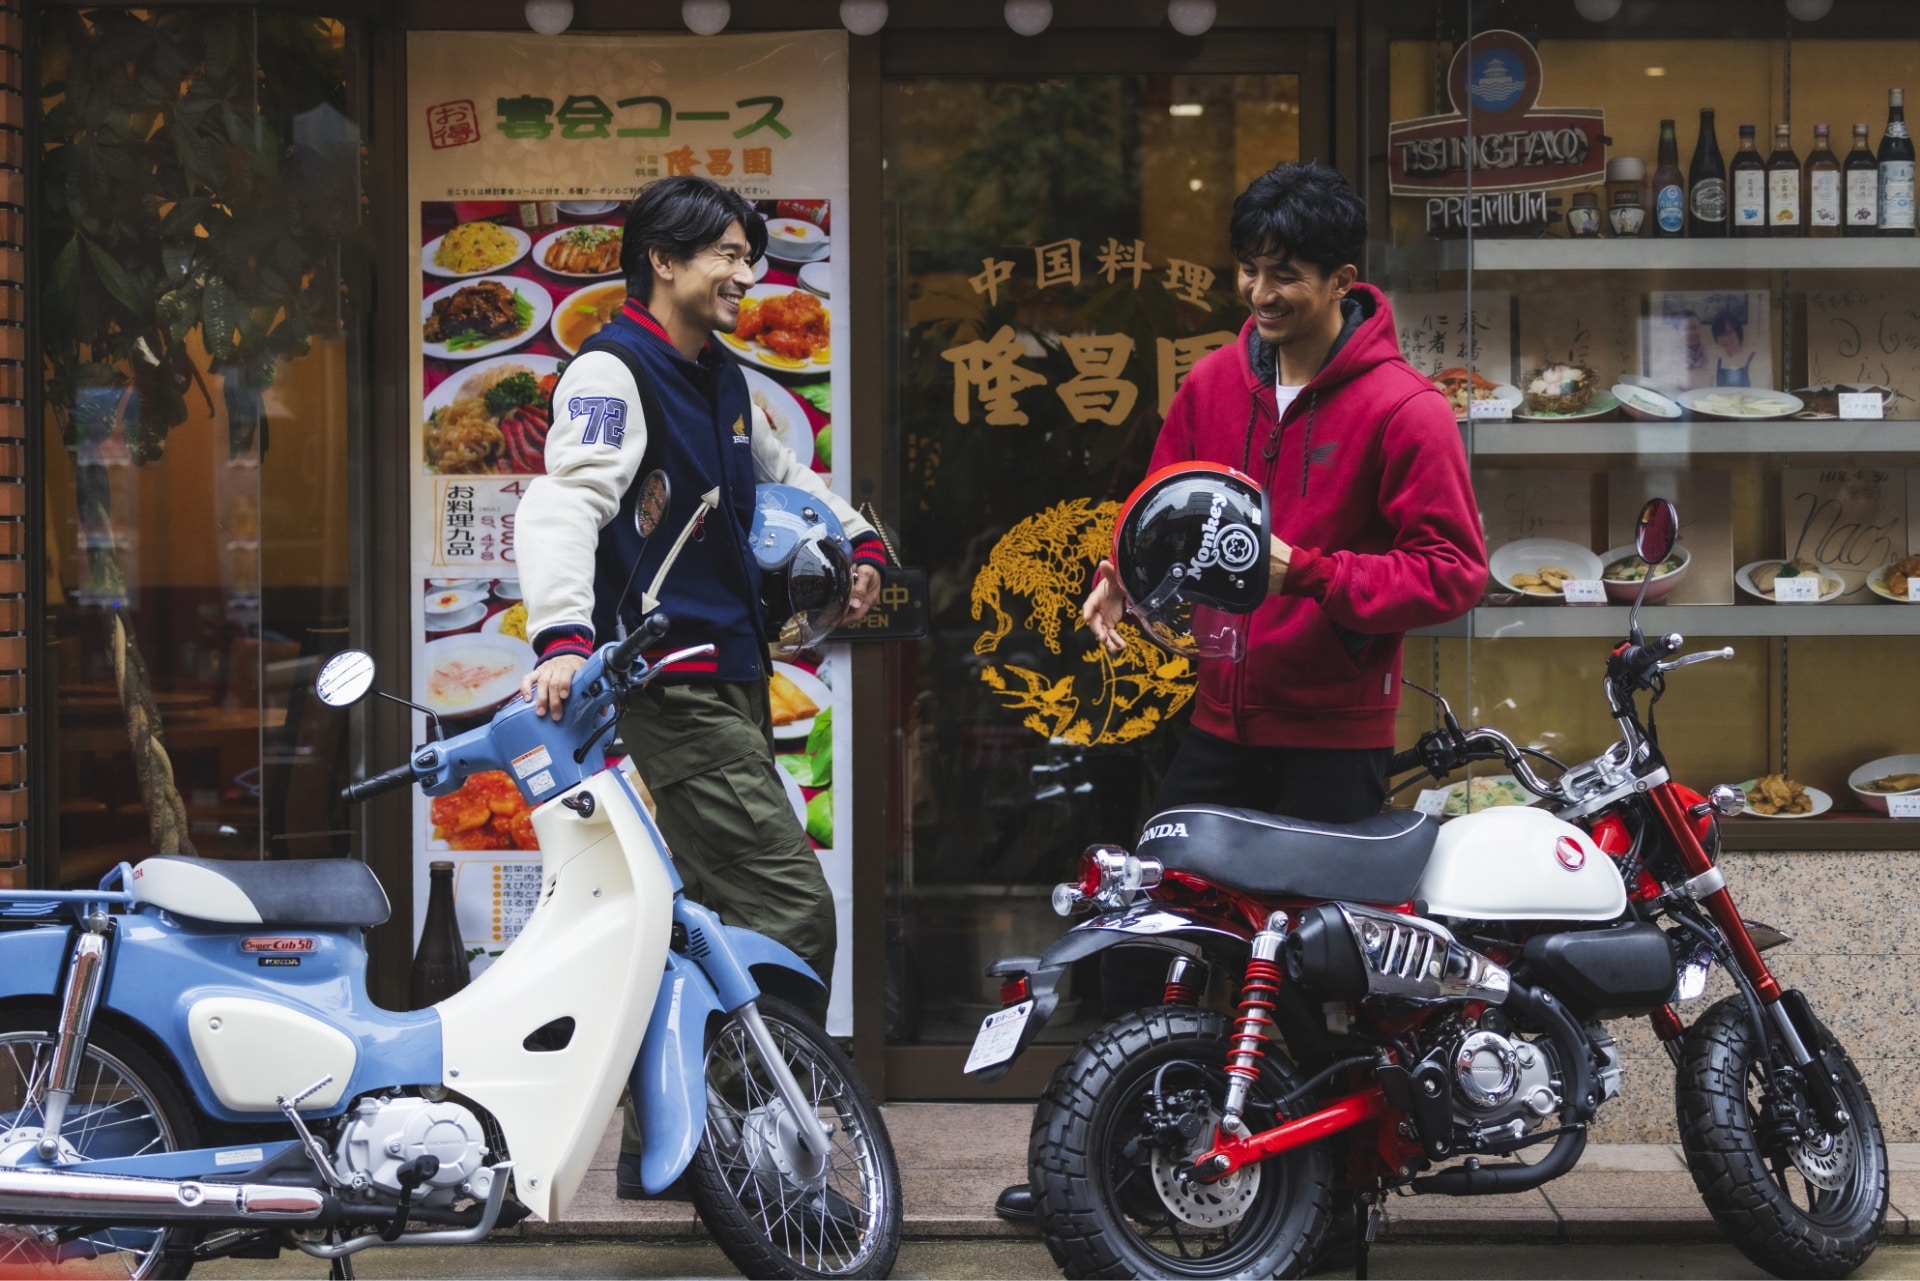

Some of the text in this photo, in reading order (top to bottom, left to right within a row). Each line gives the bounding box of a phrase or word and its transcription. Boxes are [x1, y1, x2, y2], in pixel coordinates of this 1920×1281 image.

[434, 106, 474, 146] お得
[496, 94, 792, 139] 宴会コース
[1393, 127, 1589, 173] TSINGTAO
[1426, 190, 1548, 232] PREMIUM
[968, 237, 1215, 312] 中国料理
[447, 485, 475, 556] お料理九品
[1187, 492, 1228, 581] Monkey
[873, 583, 909, 612] 中
[848, 614, 889, 629] PEN
[247, 940, 313, 950] Super Cub 50
